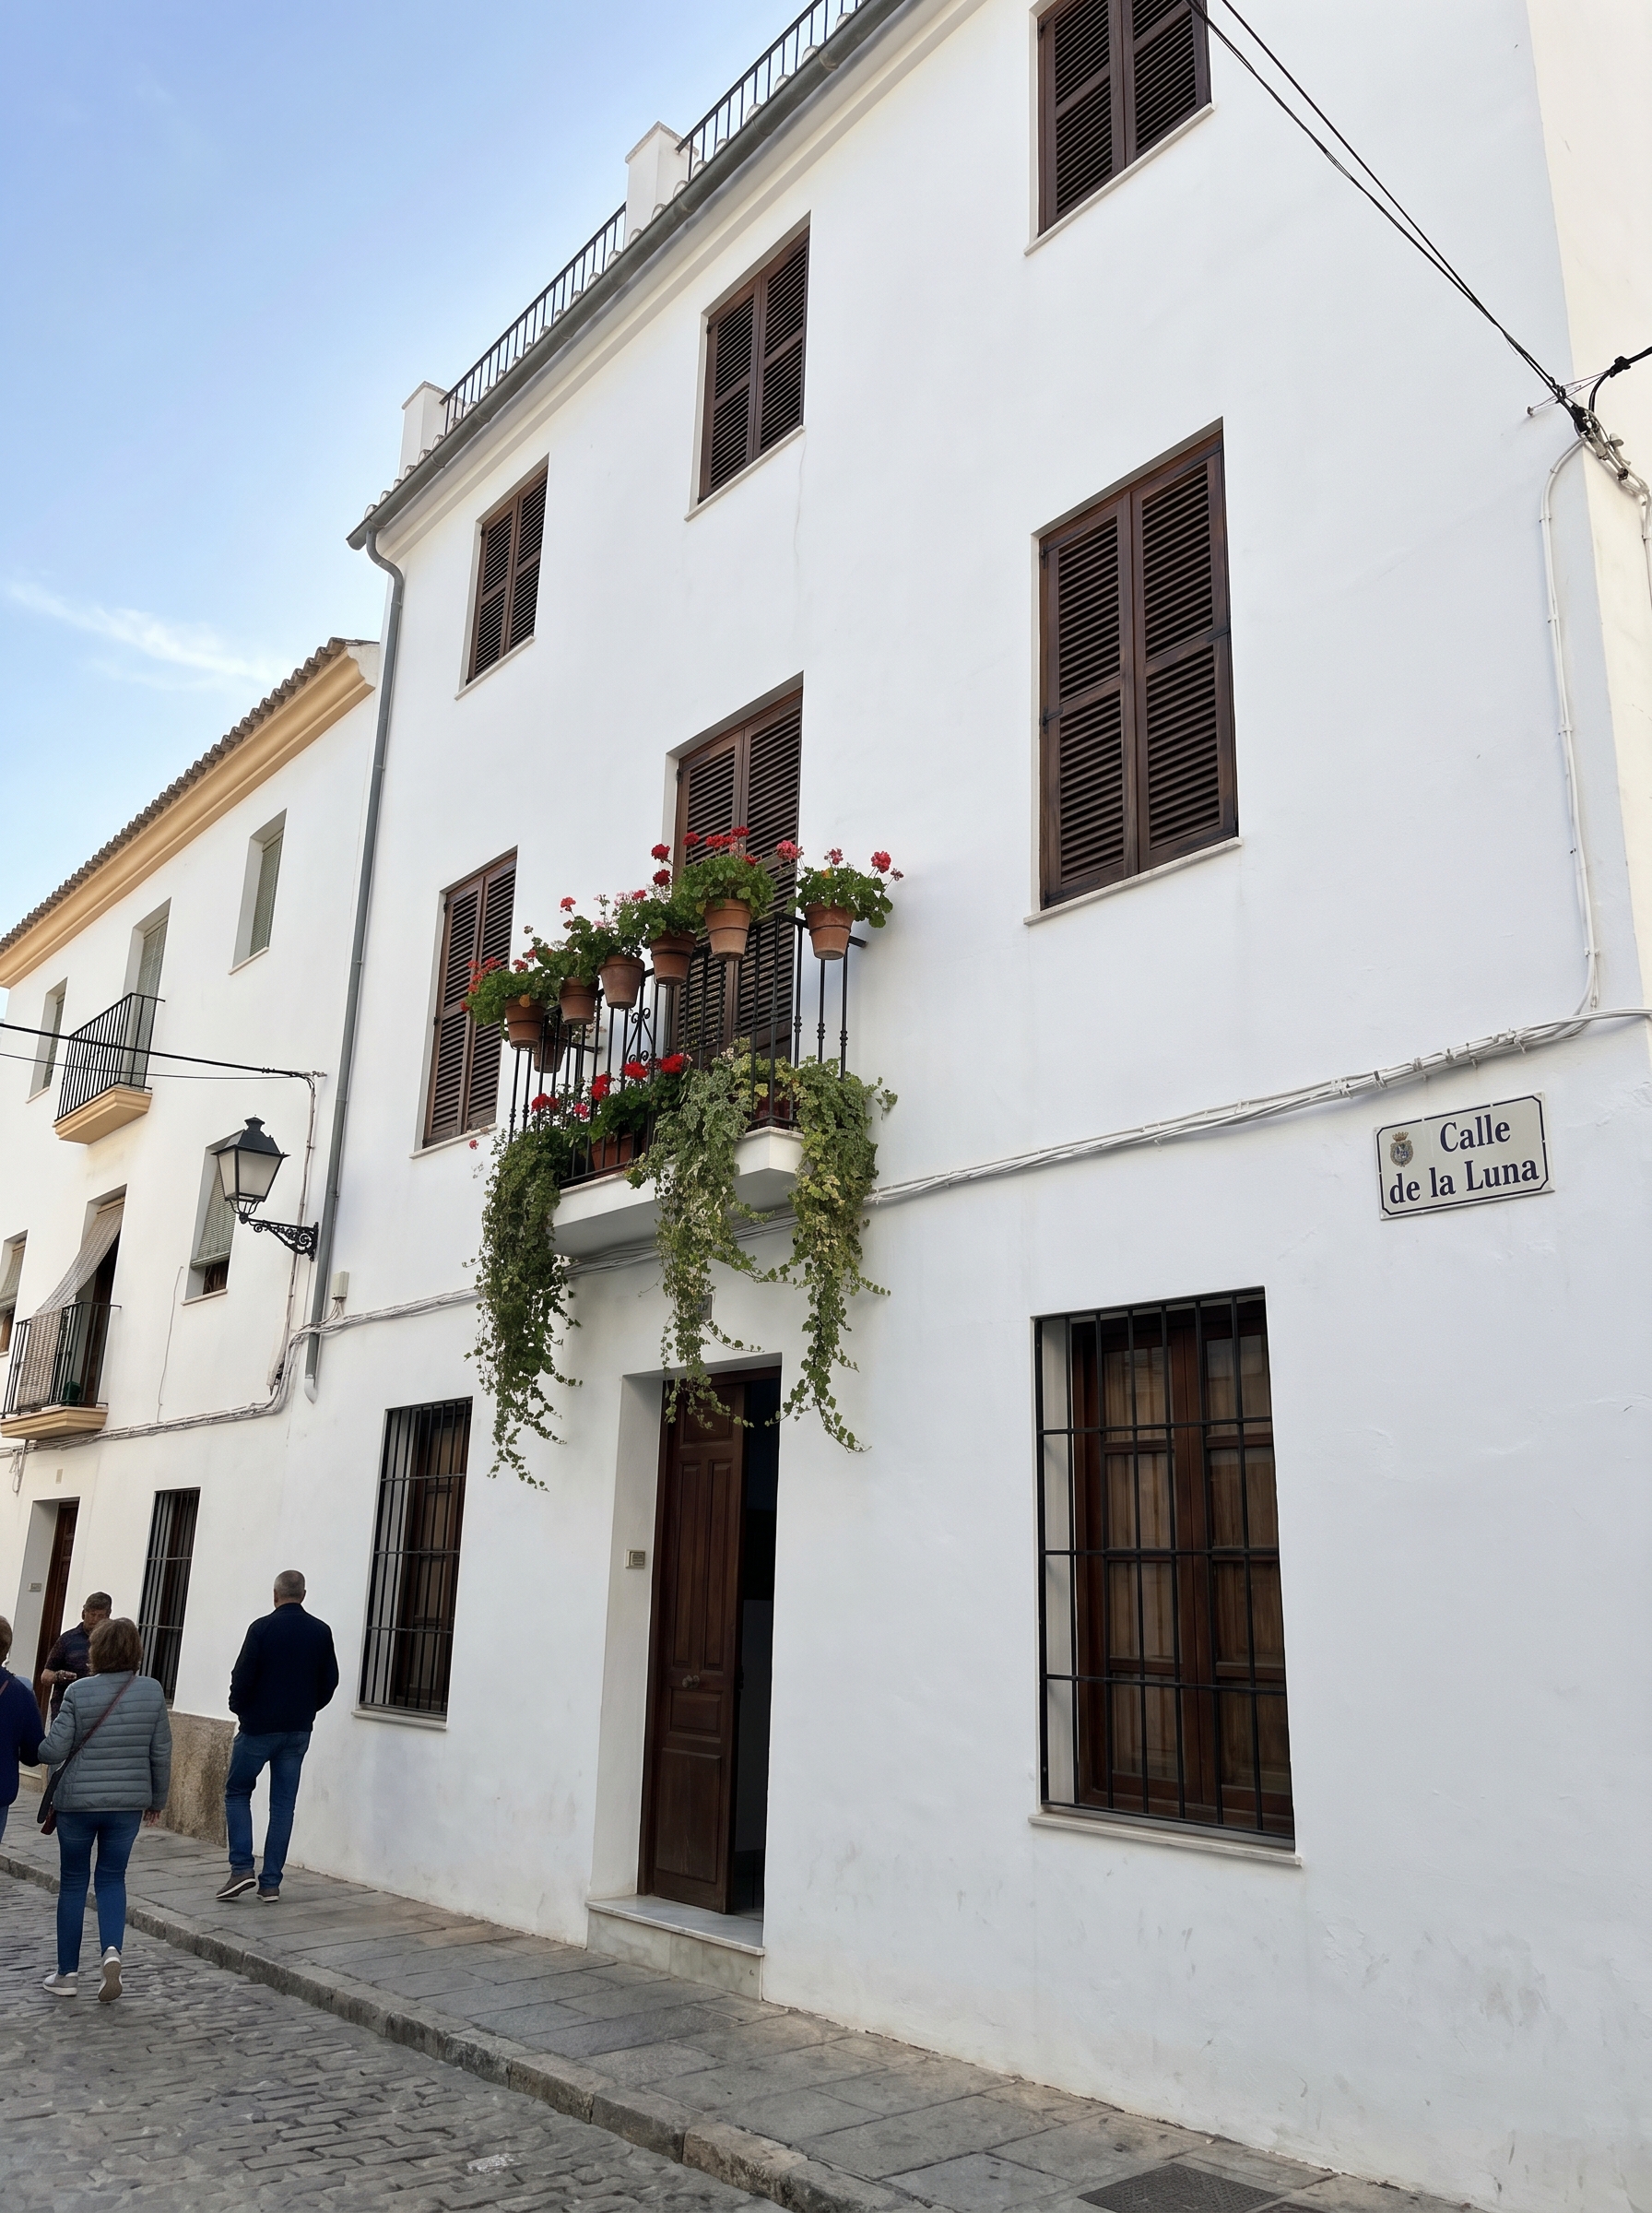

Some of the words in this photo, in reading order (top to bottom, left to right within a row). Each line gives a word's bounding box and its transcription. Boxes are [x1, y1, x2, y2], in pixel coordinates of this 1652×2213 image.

[1440, 1114, 1510, 1152] Calle
[1389, 1173, 1421, 1203] de
[1429, 1167, 1456, 1198] la
[1464, 1159, 1540, 1191] Luna
